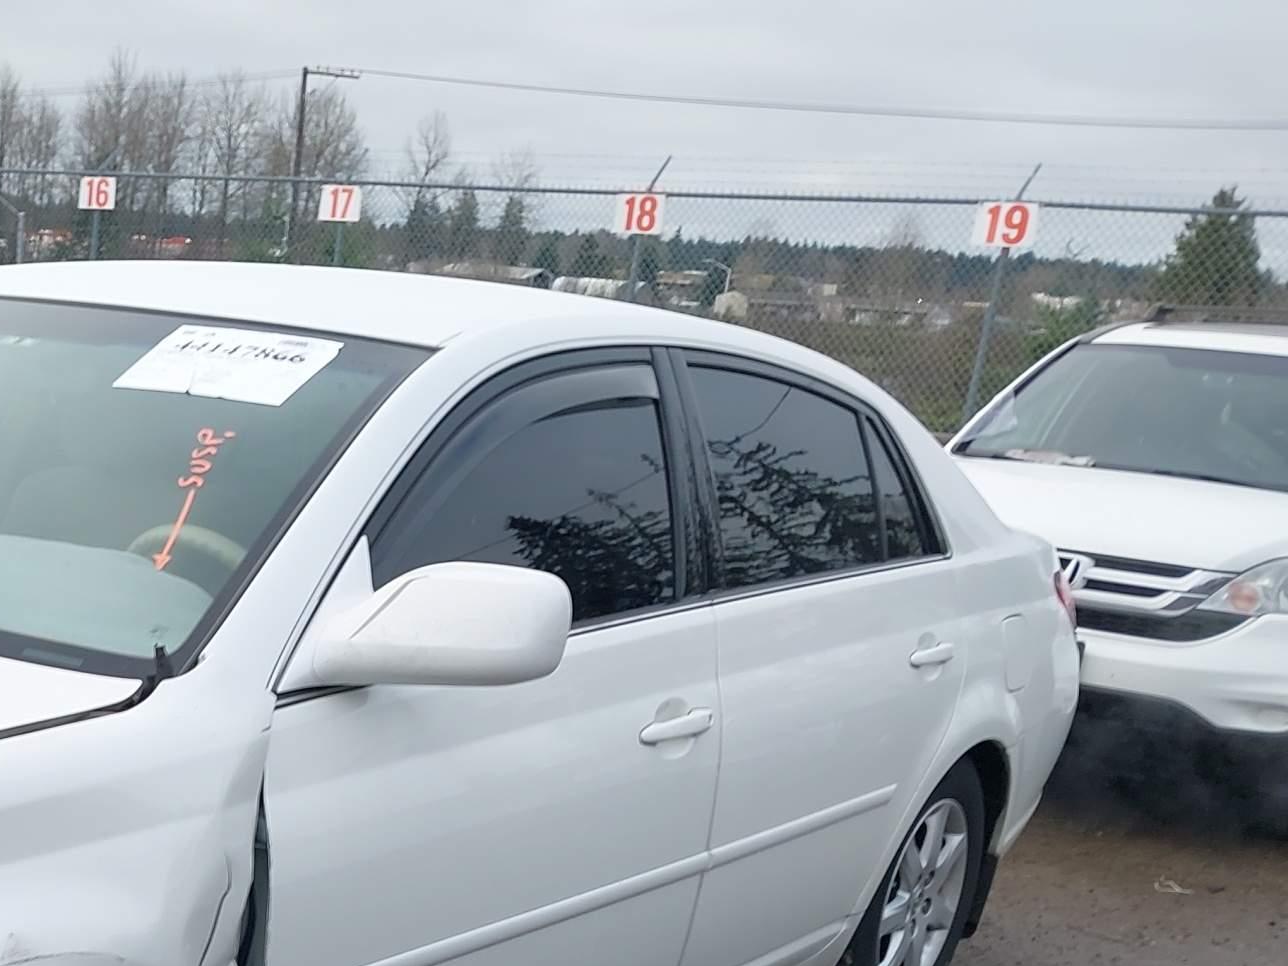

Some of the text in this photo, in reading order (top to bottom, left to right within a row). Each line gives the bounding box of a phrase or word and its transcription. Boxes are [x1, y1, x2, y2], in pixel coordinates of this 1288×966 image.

[86, 178, 109, 208] 16
[330, 187, 355, 218] 17
[624, 195, 658, 232] 18
[985, 204, 1030, 245] 19
